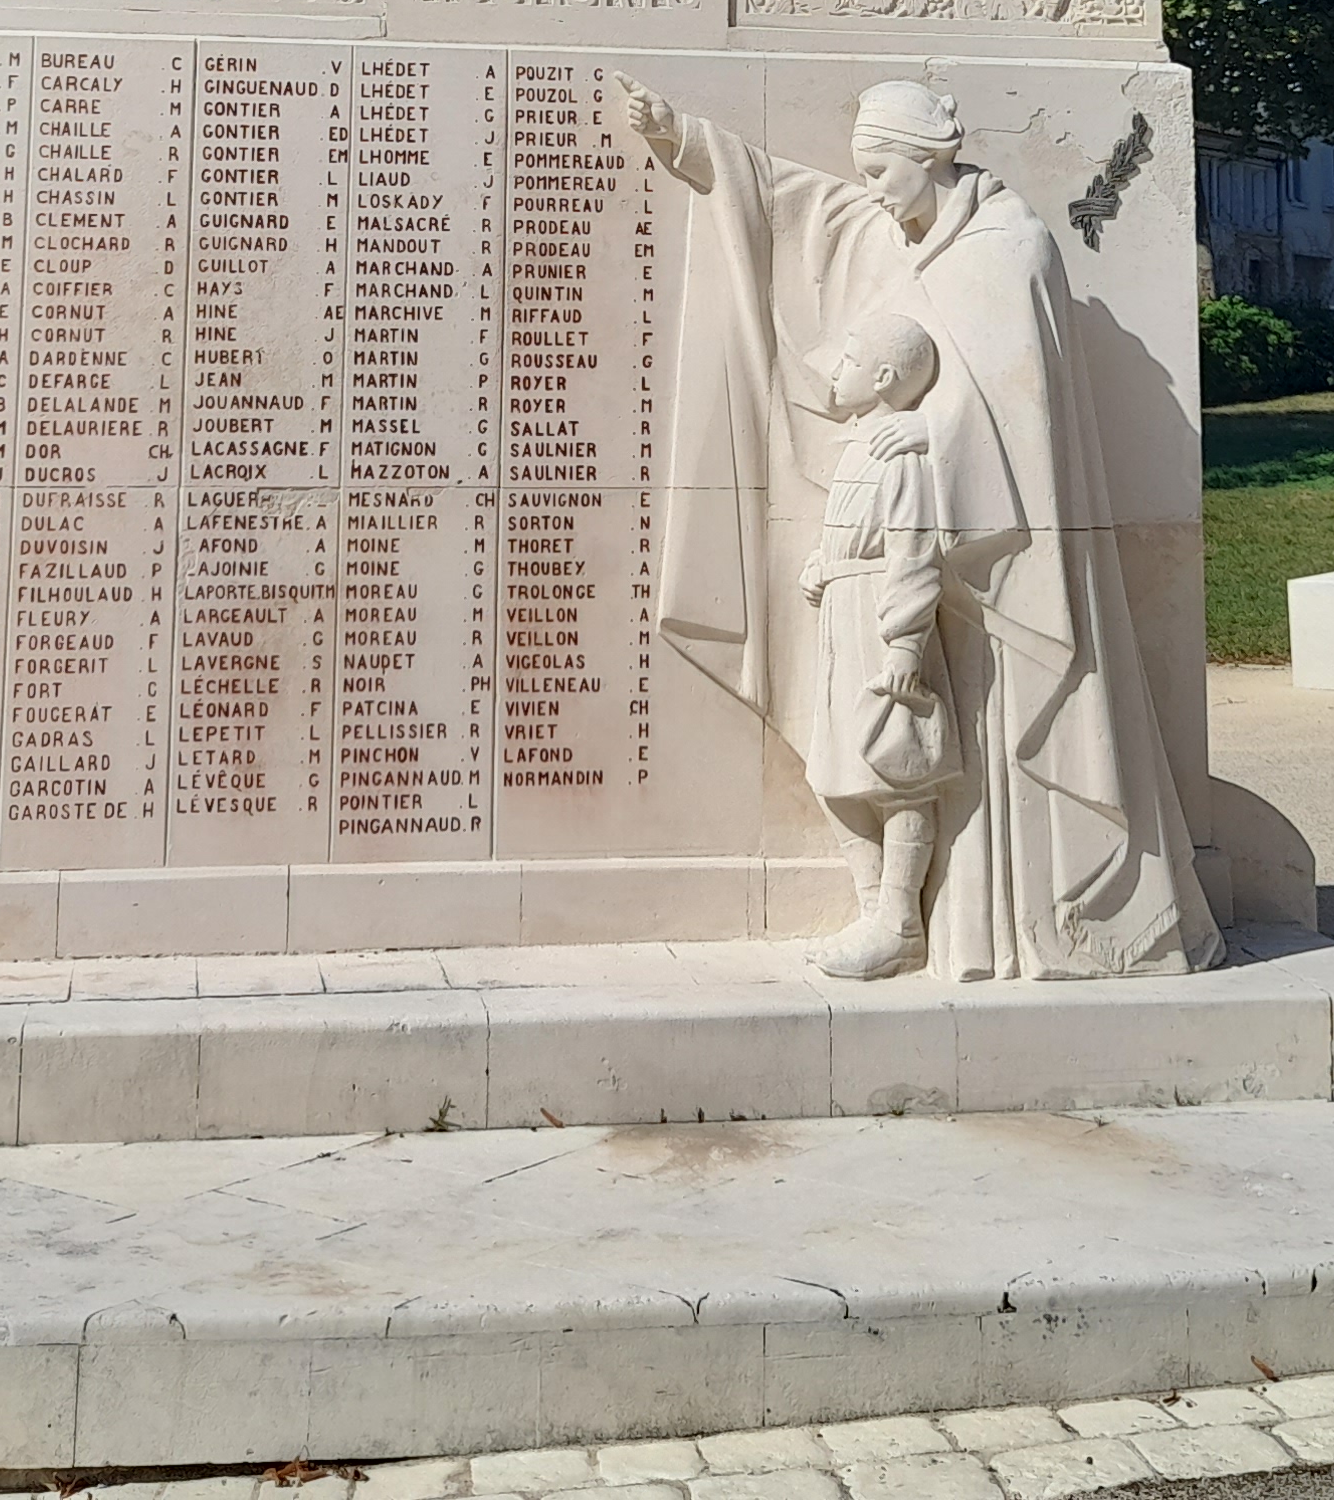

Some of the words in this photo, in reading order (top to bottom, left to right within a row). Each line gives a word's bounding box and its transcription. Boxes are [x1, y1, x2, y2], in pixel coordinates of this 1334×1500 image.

[42, 53, 114, 69] BUREAU
[516, 66, 574, 81] POUZIT
[41, 76, 122, 92] CARCALY
[205, 79, 318, 96] GINGUENAUD
[516, 88, 578, 103] POUZOL
[204, 102, 280, 118] GONTIER
[516, 109, 577, 125] PRIEUR
[40, 122, 111, 138] CHAILLE
[203, 124, 279, 140] GONTIER
[515, 131, 577, 147] PRIEUR
[39, 144, 111, 160] CHAILLE
[203, 146, 279, 162] GONTIER
[359, 150, 430, 165] LHOMME
[515, 153, 624, 170] POMMEREAUD
[38, 167, 123, 183] CHALARD
[201, 169, 278, 184] GONTIER
[359, 172, 410, 187] LIAUD
[514, 175, 616, 192] POMMEREAU
[37, 189, 114, 205] CHASSIN
[201, 191, 278, 206] GONTIER
[358, 194, 443, 209] LOSKADY
[514, 198, 603, 213] POURREAU
[200, 214, 289, 229] GUIGNARD
[514, 220, 590, 235] PRODEAU
[34, 236, 130, 251] CLOCHARD
[199, 236, 287, 251] GUIGNARD
[357, 238, 441, 253] MANDOUT
[513, 242, 590, 257] PRODEAU
[34, 259, 91, 273] CLOUP
[198, 259, 268, 273] GUILLOT
[356, 260, 454, 276] MARCHAND
[513, 264, 586, 279] PRUNIER
[33, 282, 112, 296] COIFFIER
[356, 283, 453, 298] MARCHAND
[513, 286, 582, 304] QUINTIN
[32, 305, 105, 320] CORNUT
[197, 304, 237, 319] HINE
[355, 305, 443, 321] MARCHIVE
[512, 308, 582, 323] RIFFAUD
[31, 328, 106, 342] CORNUT
[196, 327, 236, 341] HINE
[354, 328, 418, 343] MARTIN
[512, 331, 589, 346] ROULLET
[354, 351, 418, 366] MARTIN
[511, 354, 597, 369] ROUSSEAU
[29, 374, 110, 389] DEFARGE
[195, 372, 241, 387] JEAN
[353, 373, 417, 388] MARTIN
[511, 376, 566, 391] ROYER
[28, 397, 139, 413] DELALANDE
[193, 395, 303, 410] JOUANNAUD
[353, 396, 417, 411] MARTIN
[511, 399, 565, 413] ROYER
[27, 420, 142, 436] DELAURIERE
[193, 418, 274, 433] JOUBERT
[352, 419, 420, 434] MASSEL
[511, 421, 579, 436] SALLAT
[26, 444, 61, 459] DOR
[192, 441, 308, 456] LACASSAGNE
[351, 441, 436, 456] MATIGNON
[510, 442, 596, 457] SAULNIER
[25, 467, 95, 482] DUCROS
[191, 464, 266, 481] LACROIX
[510, 465, 597, 481] SAULNIER
[23, 492, 126, 508] DUFRAISSE
[508, 493, 601, 507] SAUVIGNON
[22, 516, 84, 531] DULAC
[348, 515, 437, 530] MIAILLIER
[508, 515, 574, 531] SORTON
[20, 540, 107, 555] DUVOISIN
[347, 538, 400, 553] MOINE
[508, 538, 574, 553] THORET
[19, 563, 126, 579] FAZILLAUD
[347, 561, 399, 576] MOINE
[508, 561, 585, 576] THOUBEY
[18, 586, 132, 603] FILHOULAUD
[346, 584, 417, 599] MOREAU
[507, 584, 595, 600] TROLONGE
[17, 611, 90, 627] FLEURY
[184, 608, 287, 623] LARGEAULT
[345, 607, 416, 622] MOREAU
[507, 608, 577, 623] VEILLON
[16, 634, 114, 650] FORGEAUD
[183, 632, 253, 647] LAVAUD
[345, 630, 416, 646] MOREAU
[507, 631, 578, 646] VEILLON
[15, 658, 108, 674] FORGERIT
[182, 655, 280, 671] LAVERGNE
[506, 654, 585, 670] VIGEOLAS
[13, 682, 62, 699] FORT
[343, 677, 385, 692] NOIR
[506, 677, 600, 693] VILLENEAU
[343, 700, 418, 716] PATCINA
[506, 701, 559, 716] VIVIEN
[179, 725, 265, 742] LEPETIT
[342, 723, 447, 739] PELLISSIER
[505, 724, 558, 740] VRIET
[12, 731, 93, 747] GADRAS
[178, 750, 255, 766] LETARD
[341, 747, 418, 764] PINCHON
[504, 748, 573, 763] LAFOND
[11, 754, 110, 773] GAILLARD
[341, 770, 461, 788] PINGANNAUD
[504, 770, 603, 787] NORMANDIN
[10, 779, 106, 797] GARCOTIN
[340, 794, 422, 810] POINTIER
[9, 803, 96, 820] GAROSTE
[104, 802, 127, 819] DE
[339, 817, 461, 835] PINGANNAUD
